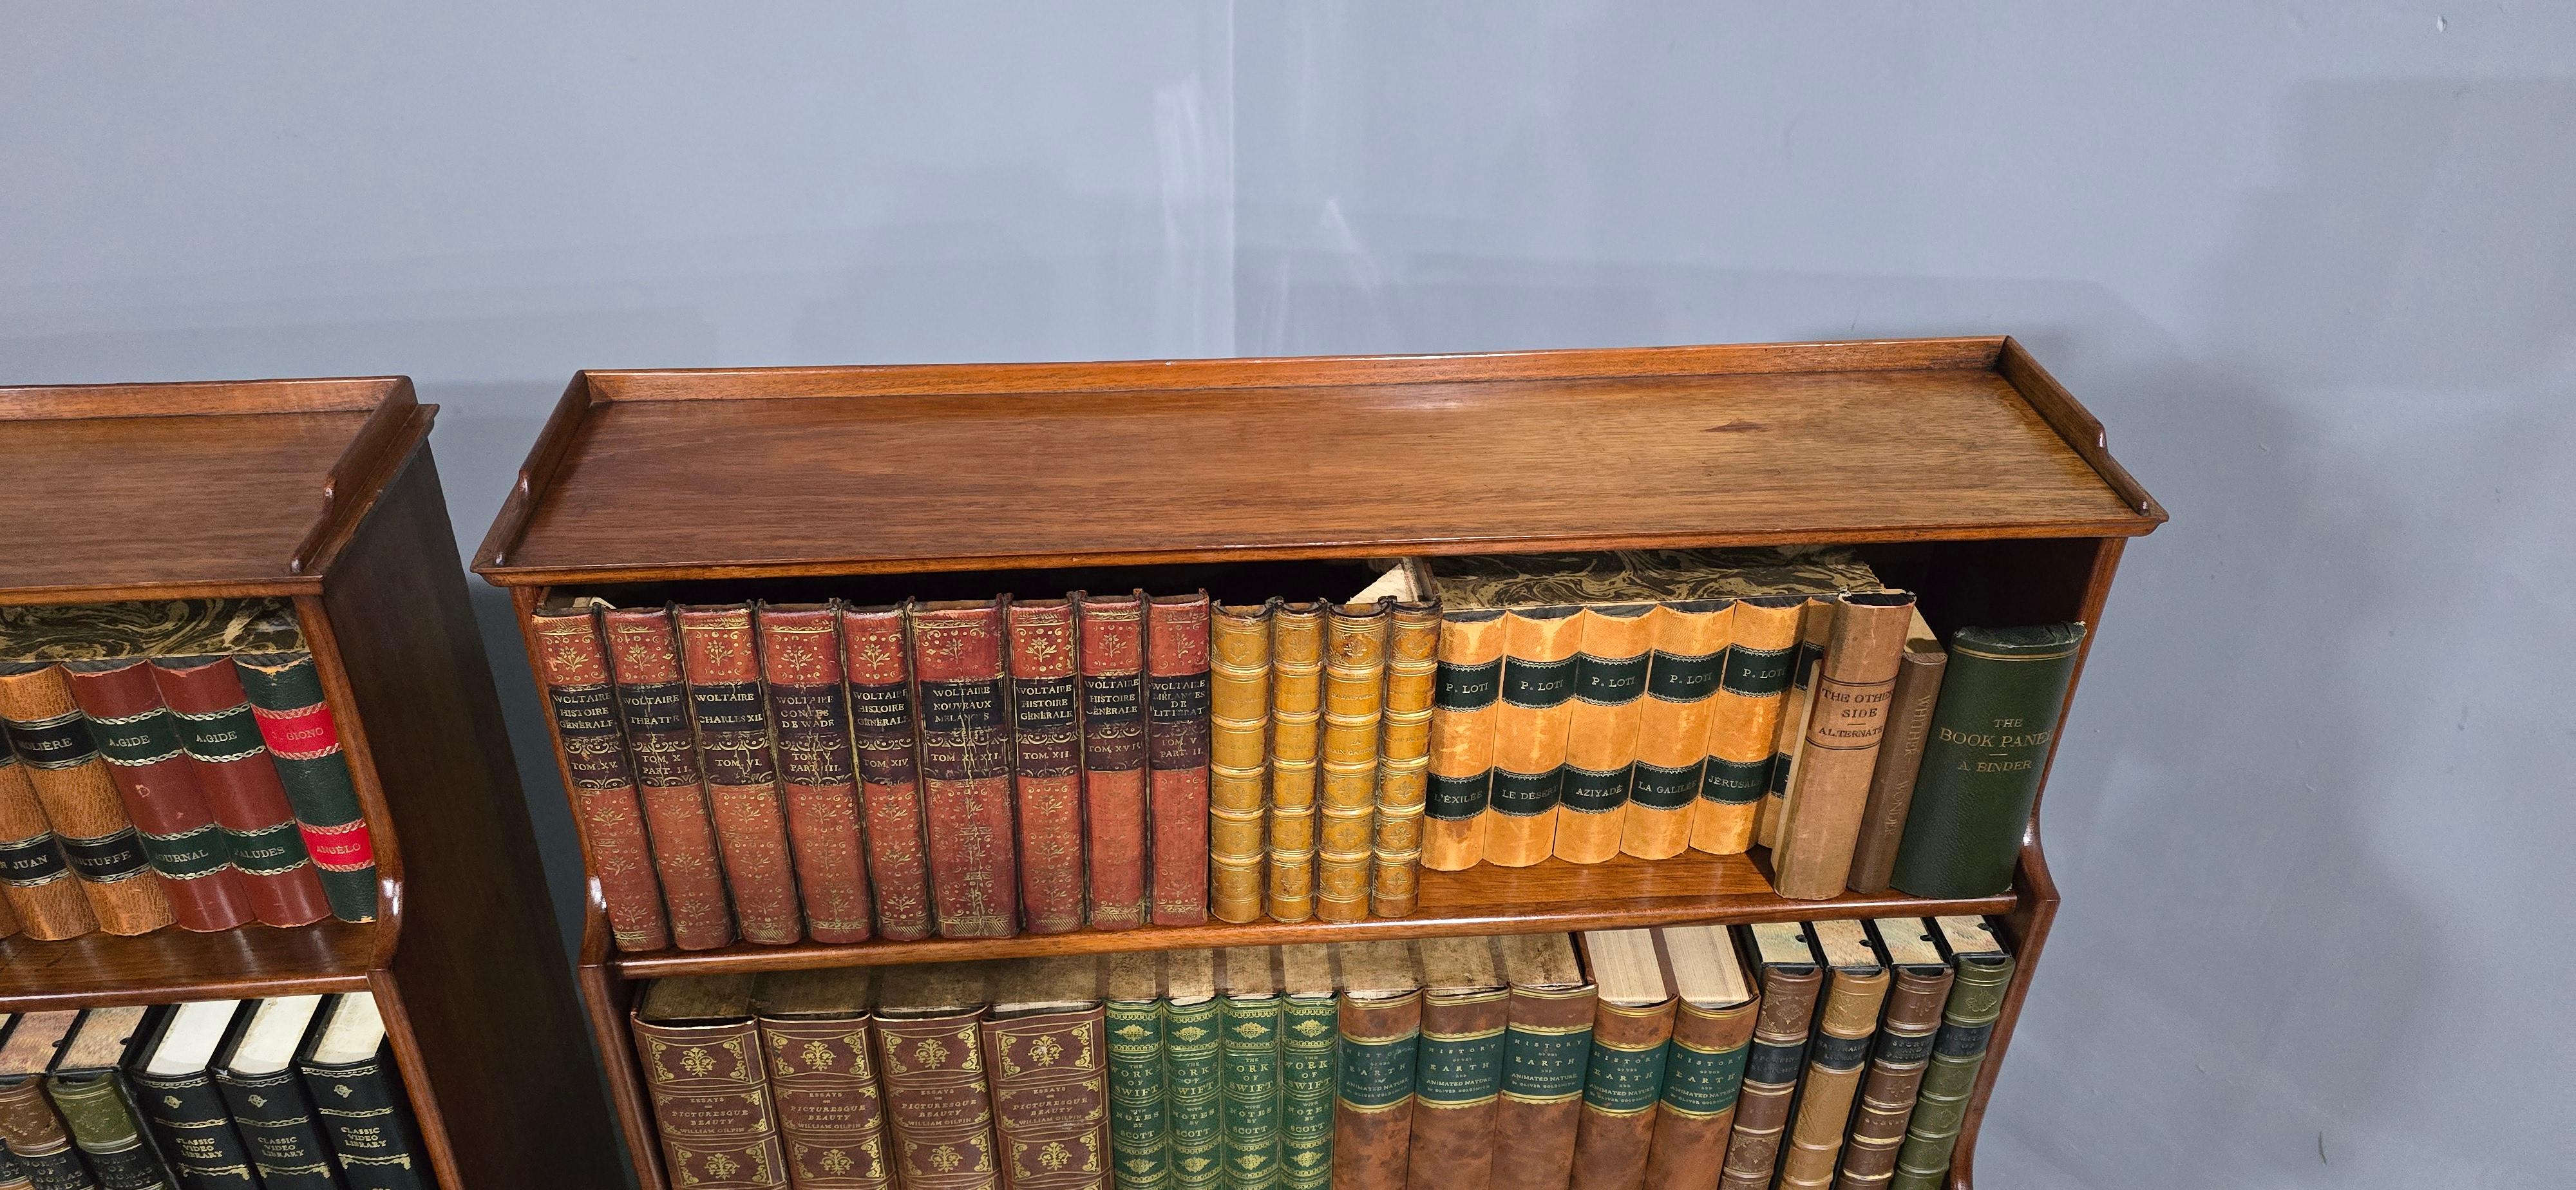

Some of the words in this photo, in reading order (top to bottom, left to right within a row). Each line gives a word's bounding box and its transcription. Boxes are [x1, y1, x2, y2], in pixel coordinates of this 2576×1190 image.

[1670, 675, 1683, 685] P.
[1687, 672, 1713, 685] LOTI
[1743, 668, 1756, 678] P.
[1760, 668, 1786, 679] LOTI
[1520, 681, 1533, 690] P.
[1538, 679, 1563, 691] LOTI
[1592, 676, 1605, 686] P.
[1609, 676, 1635, 688] LOTI
[1446, 683, 1458, 692] P.
[1463, 682, 1489, 694] LOTI
[1090, 694, 1135, 703] HISTOIRE
[1822, 688, 1850, 703] THE
[1021, 699, 1068, 708] HISTOIRE
[560, 707, 609, 717] HISTOIRE
[1842, 708, 1878, 718] SIDE
[1994, 719, 2023, 728] THE
[196, 731, 237, 742] A.GIDE
[286, 727, 324, 740] GIONO
[1939, 727, 1996, 747] BOOK
[109, 735, 150, 747] A.GIDE
[1976, 760, 2033, 773] BINDER
[1576, 784, 1623, 797] AZIYADÉ
[1638, 780, 1653, 792] LA
[1502, 789, 1516, 800] LE
[1521, 784, 1558, 800] DÉSERT
[14, 855, 48, 869] JUAN
[1429, 1044, 1495, 1054] HISTORY
[1515, 1039, 1582, 1048] HISTORY
[1431, 1062, 1489, 1071] EARTH
[1515, 1056, 1575, 1066] EARTH
[1350, 1064, 1405, 1076] EARTH
[1595, 1069, 1653, 1081] EARTH
[1676, 1070, 1735, 1083] EARTH
[1171, 1081, 1214, 1095] SWIFT
[1229, 1081, 1273, 1092] SWIFT
[1288, 1077, 1331, 1090] SWIFT
[1347, 1081, 1381, 1091] ANIMATED
[1115, 1084, 1159, 1096] SWIFT
[1589, 1084, 1626, 1095] ANIMATED
[1670, 1086, 1708, 1098] ANIMATED
[902, 1100, 977, 1109] PICTURESQUE
[1013, 1098, 1088, 1110] PICTURESQUE
[1030, 1108, 1072, 1116] BEAUTY
[1176, 1128, 1210, 1137] SCOTT
[1233, 1126, 1267, 1134] SCOTT
[1290, 1122, 1325, 1132] SCOTT
[1121, 1130, 1155, 1139] SCOTT
[345, 1140, 387, 1148] LIBRARY
[181, 1150, 223, 1158] LIBRARY
